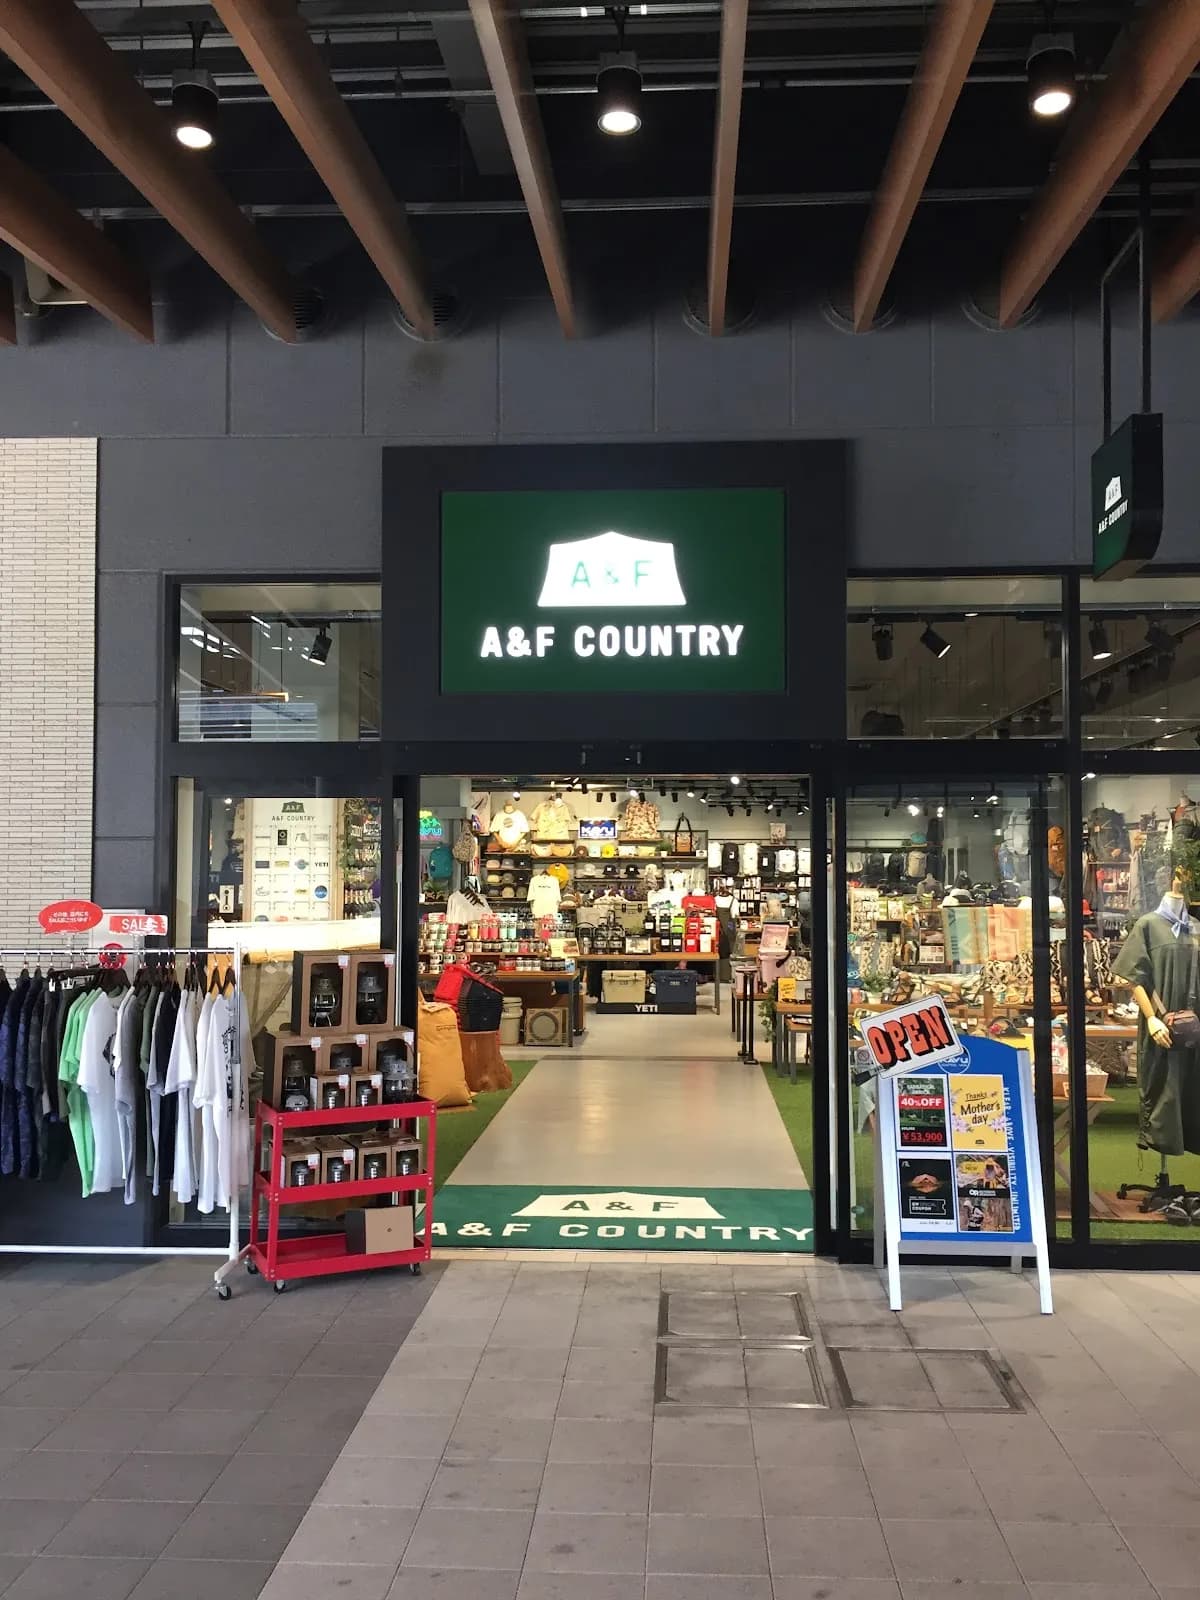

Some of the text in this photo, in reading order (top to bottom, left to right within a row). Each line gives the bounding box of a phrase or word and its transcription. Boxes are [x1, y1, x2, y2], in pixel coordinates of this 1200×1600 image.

[479, 624, 745, 658] A&F COUNTRY
[634, 1004, 658, 1013] YETI
[867, 1005, 955, 1068] OPEN
[965, 1091, 988, 1101] Thanks
[960, 1100, 1001, 1115] Mother's
[971, 1114, 989, 1125] day
[558, 1223, 815, 1242] COUNTRY
